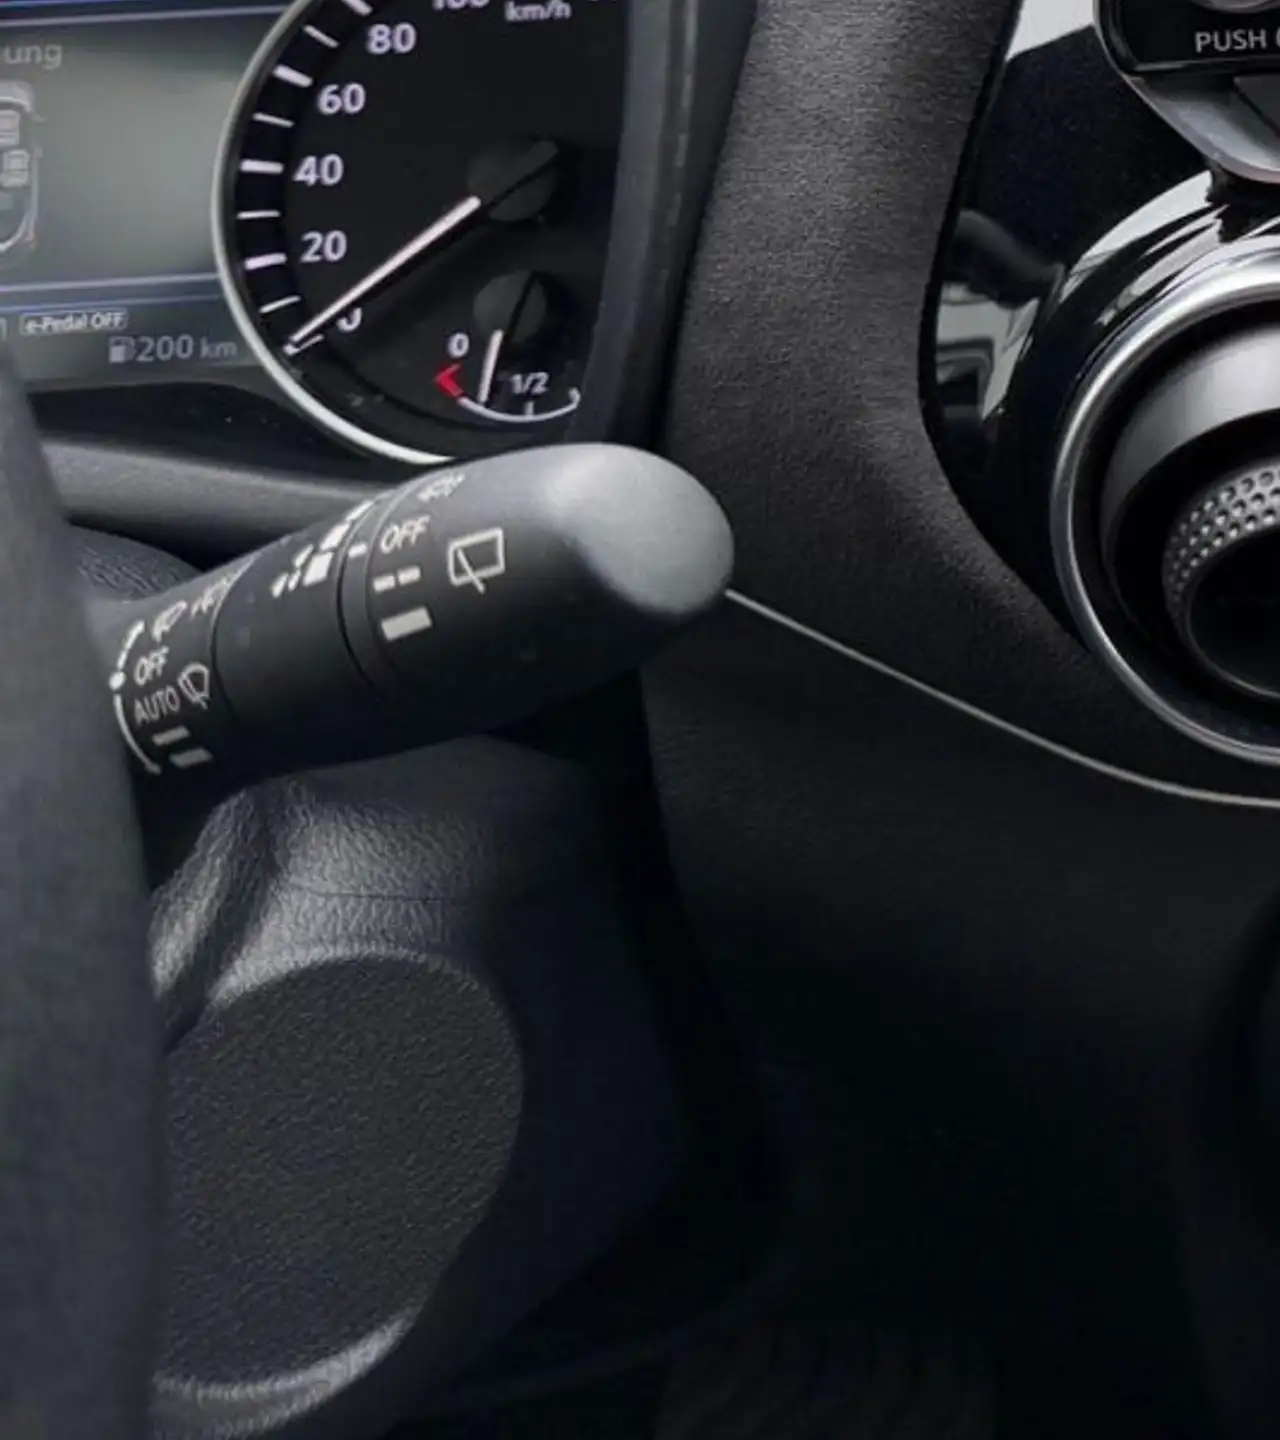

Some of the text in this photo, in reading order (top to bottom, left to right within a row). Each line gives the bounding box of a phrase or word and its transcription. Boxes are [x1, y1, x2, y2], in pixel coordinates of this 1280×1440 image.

[367, 23, 417, 55] 80
[1195, 29, 1267, 53] PUSH
[317, 82, 366, 114] 60
[293, 154, 344, 186] 40
[301, 229, 347, 261] 20
[136, 333, 237, 362] 200 km
[448, 333, 470, 357] 0
[510, 371, 549, 394] 1/2
[380, 516, 430, 554] OFF
[133, 647, 170, 686] OFF
[134, 683, 182, 725] AUTO
